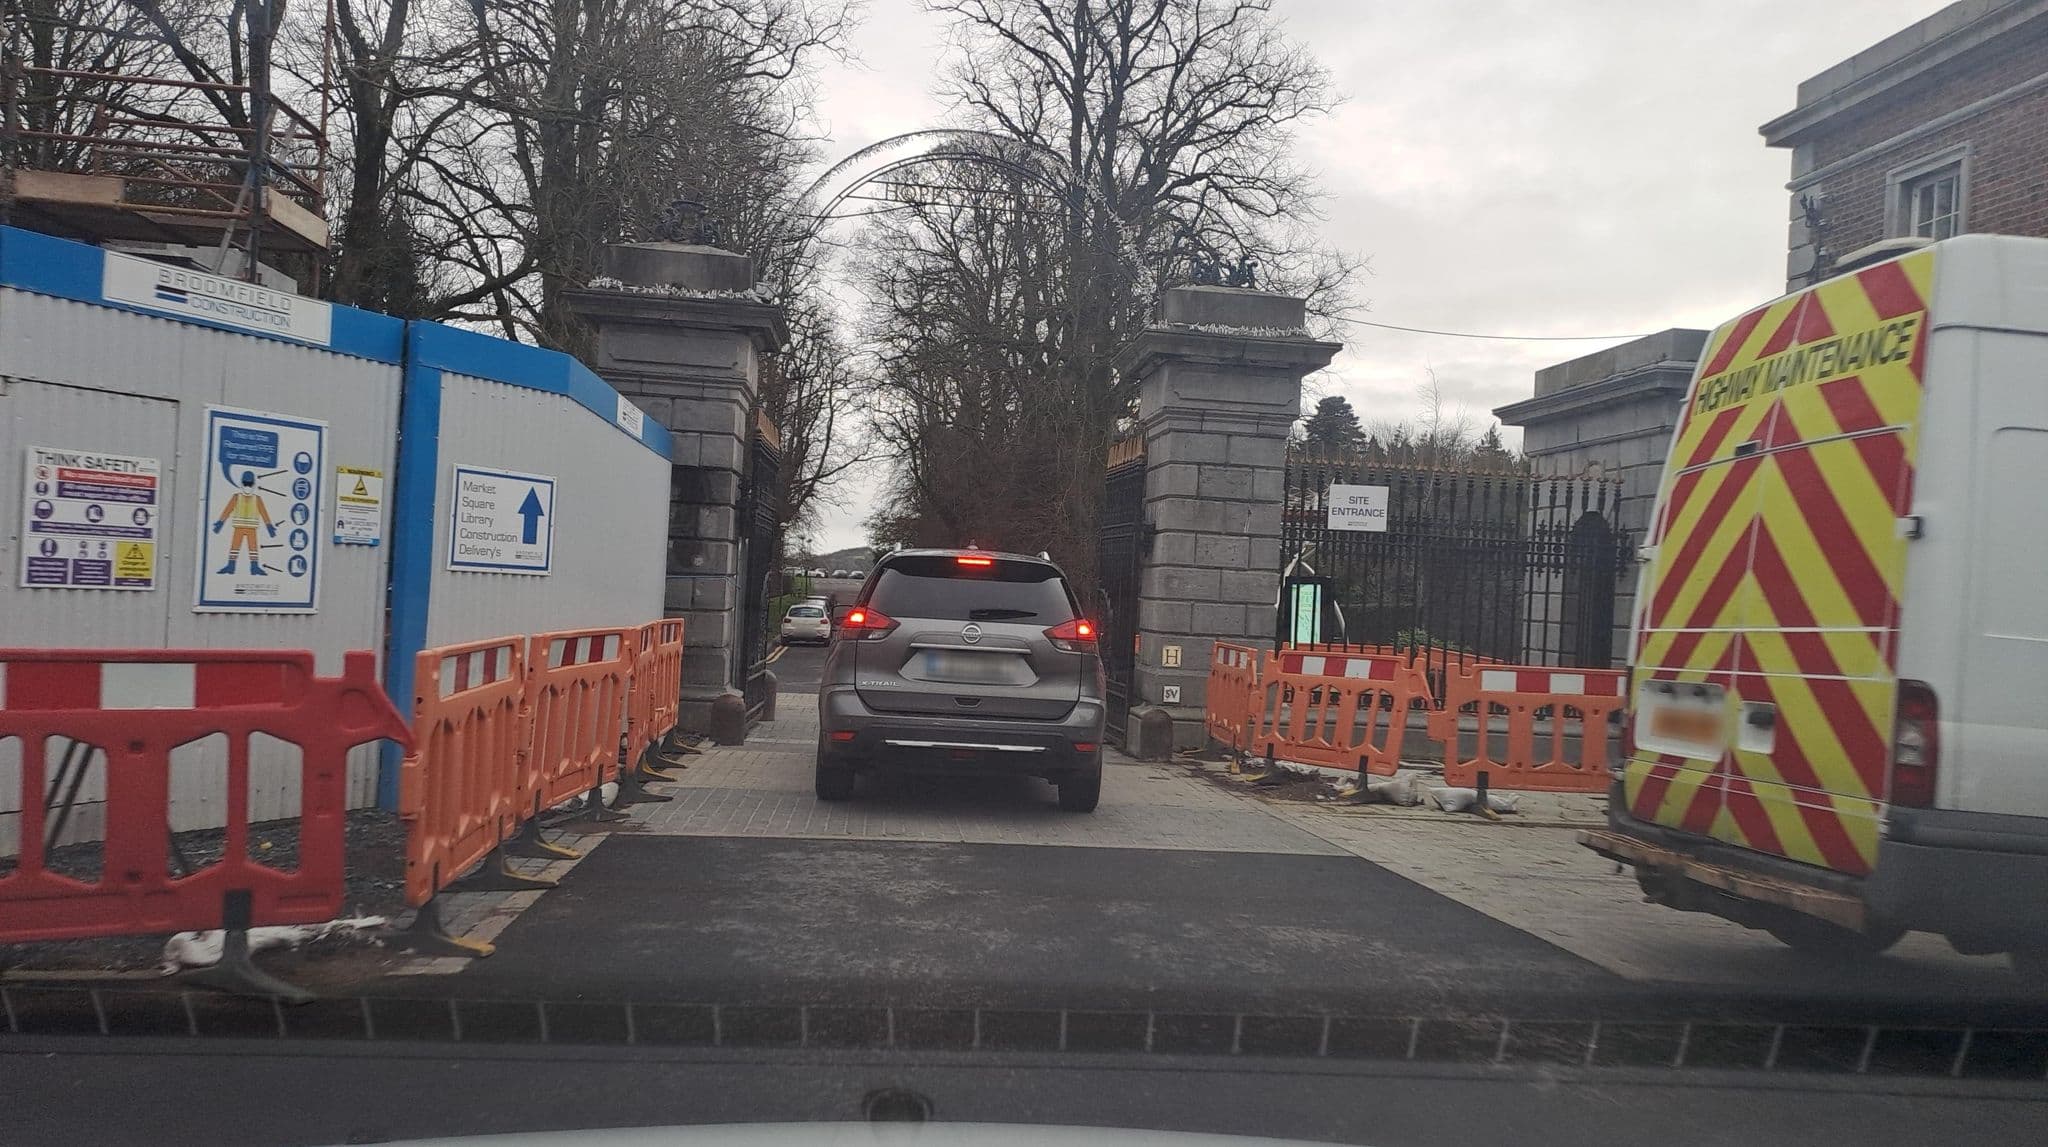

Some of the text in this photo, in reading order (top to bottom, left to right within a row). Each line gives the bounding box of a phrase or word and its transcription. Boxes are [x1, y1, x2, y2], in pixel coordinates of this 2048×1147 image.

[158, 269, 293, 310] BROOMFIELD
[188, 296, 292, 328] CONSTRUCTION
[1696, 318, 1917, 416] HIGHWAY MAINTENANCE
[36, 451, 82, 467] THINK
[84, 456, 140, 473] SAFETY
[463, 480, 497, 494] Market
[462, 496, 495, 510] Square
[1348, 496, 1370, 505] SITE
[461, 512, 494, 527] Library
[1331, 507, 1385, 518] ENTRANCE
[459, 528, 518, 542] Construction
[458, 543, 502, 559] Delivery's
[1165, 649, 1179, 665] H
